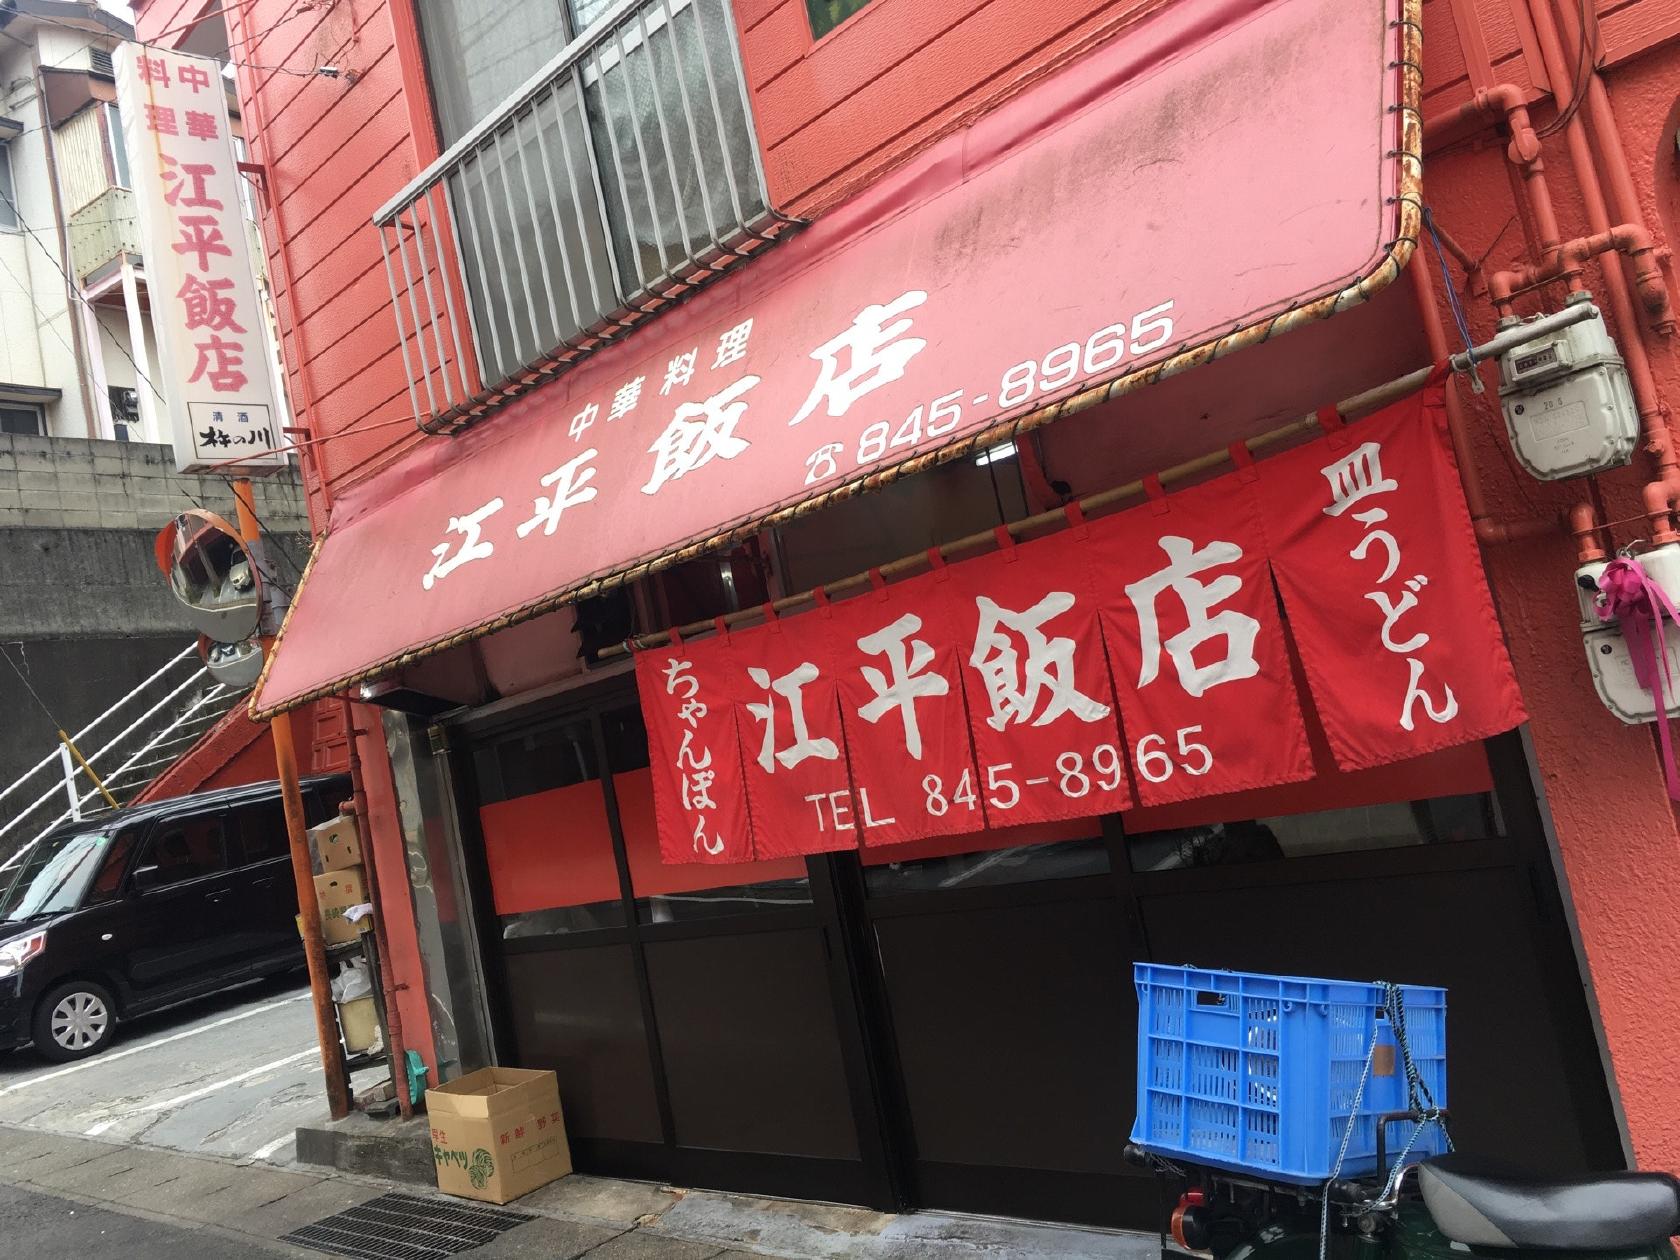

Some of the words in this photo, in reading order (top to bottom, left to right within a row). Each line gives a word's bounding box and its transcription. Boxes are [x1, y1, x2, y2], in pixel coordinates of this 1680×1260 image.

[158, 152, 249, 393] 江平飯店
[199, 425, 272, 450] 杵の川
[212, 411, 249, 424] 清酒
[421, 290, 930, 592] 江平飯店
[568, 317, 755, 443] 中華料理
[855, 299, 1175, 466] 845-8965
[746, 535, 1261, 775] 江平飯店
[1320, 442, 1459, 731] 皿うどん
[661, 657, 725, 856] ちゃんぽん
[804, 786, 897, 833] TEL
[921, 724, 1215, 818] 845-8965
